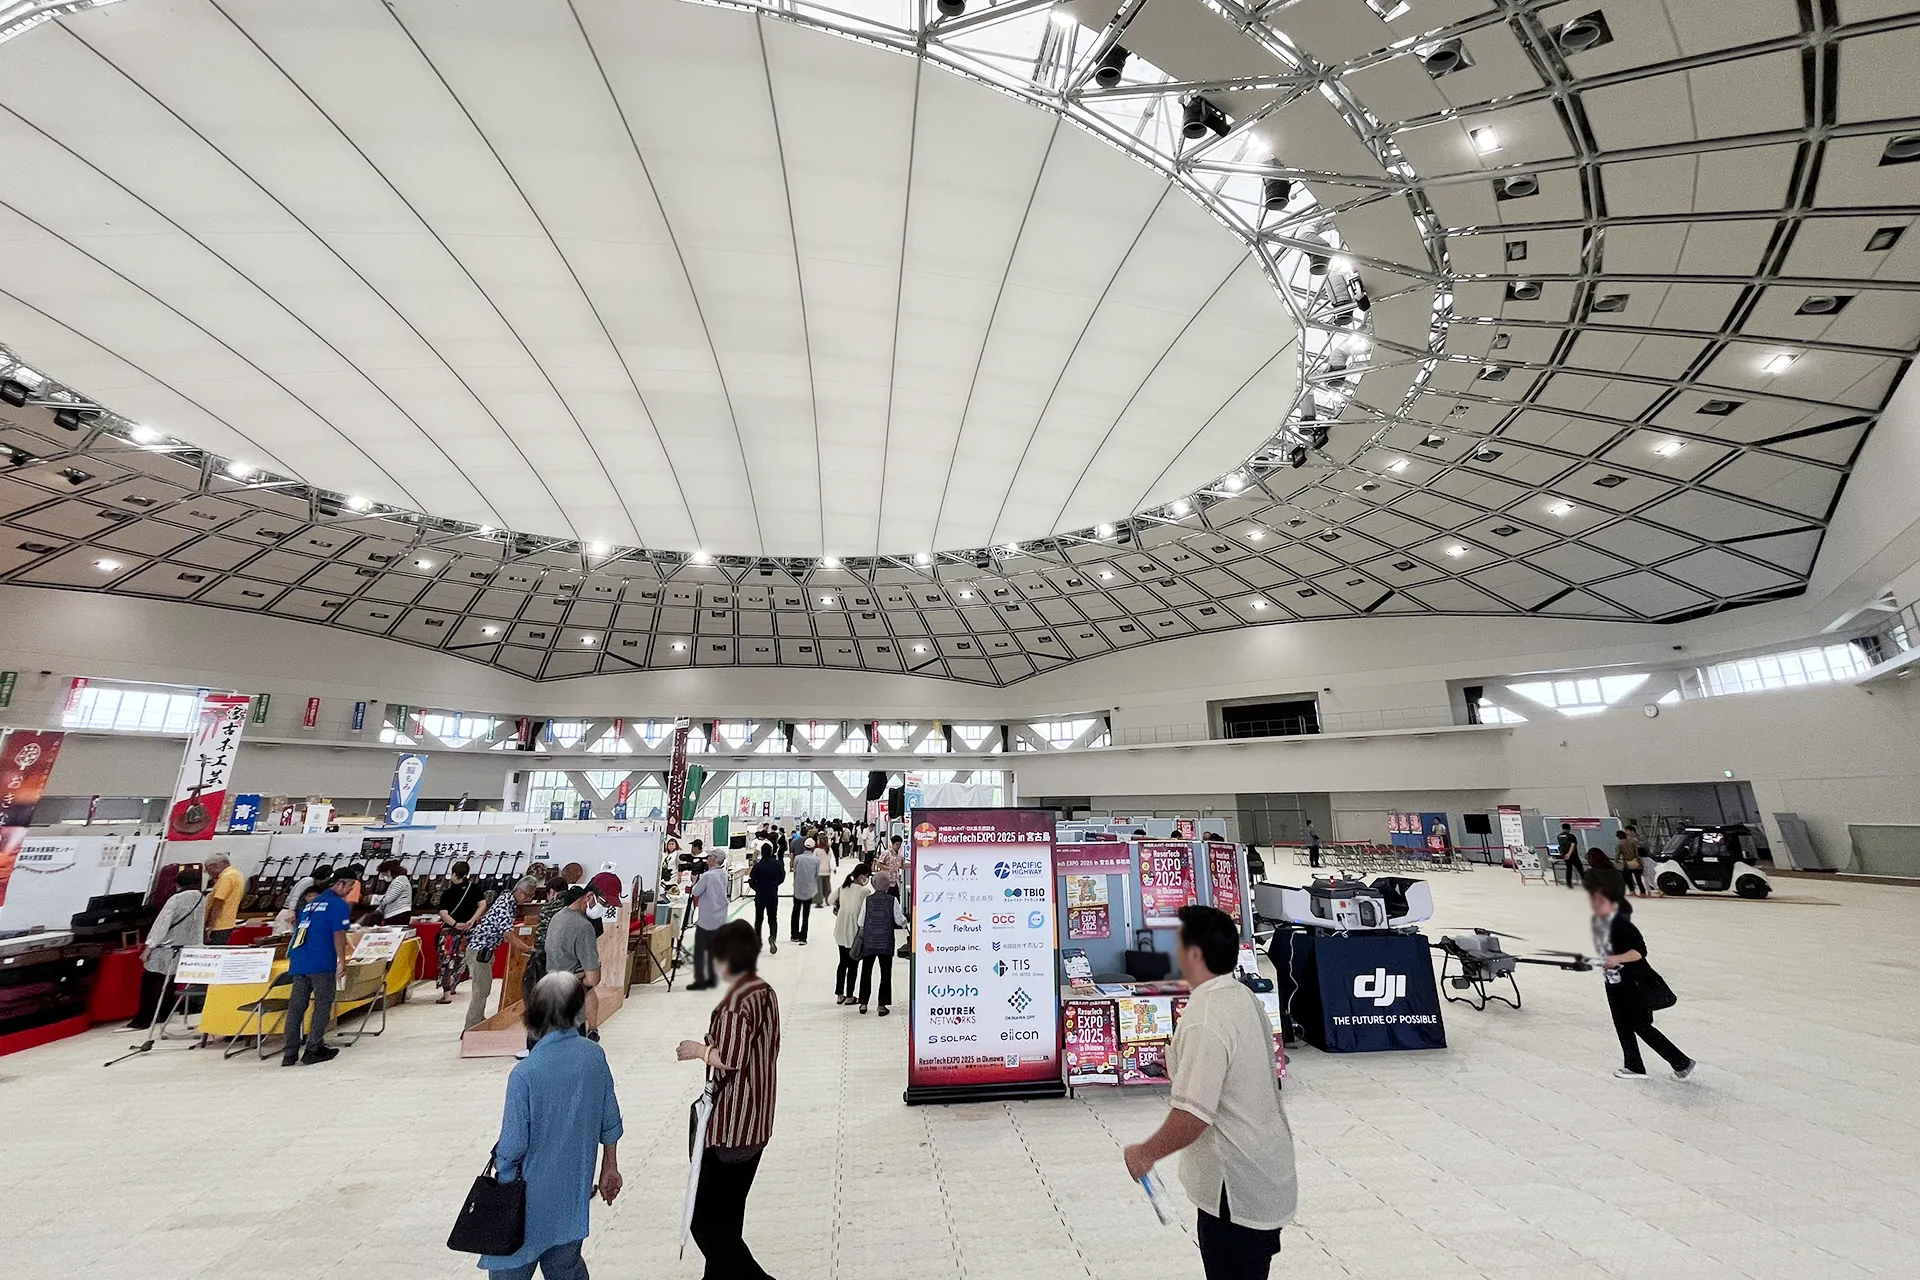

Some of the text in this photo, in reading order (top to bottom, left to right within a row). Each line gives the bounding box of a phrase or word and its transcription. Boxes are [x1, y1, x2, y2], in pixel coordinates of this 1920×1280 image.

[206, 706, 246, 785] 宮古木工芸
[938, 831, 1051, 843] ResorTech EXPO 2025 in 宮古島
[1153, 849, 1180, 858] ResorTech
[947, 861, 978, 876] Ark
[1012, 861, 1043, 869] PACIFIC
[1154, 858, 1181, 871] EXPO
[1216, 860, 1231, 874] EXPO
[1155, 871, 1182, 886] 2025
[1217, 873, 1233, 890] 2025
[1023, 888, 1045, 897] TBIO
[992, 915, 1015, 924] OCC
[1081, 914, 1097, 923] EXPO
[1082, 922, 1097, 931] 2025
[936, 944, 966, 953] toyopla
[928, 965, 978, 974] LIVING CG
[1012, 959, 1030, 970] TIS
[927, 984, 979, 998] Kubota
[1077, 1007, 1103, 1015] ResorTech
[930, 1015, 977, 1025] NETWORKS
[1077, 1015, 1103, 1029] EXPO
[1333, 1014, 1438, 1026] THE FUTURE OF POSSIBLE
[940, 1034, 978, 1043] SOLPAC
[1000, 1028, 1039, 1041] eiicon
[1078, 1028, 1104, 1043] 2025
[919, 1056, 946, 1065] ResorTech
[946, 1055, 960, 1064] EXPO
[960, 1055, 974, 1063] 2025
[982, 1055, 1004, 1063] Okinawa
[1139, 1052, 1158, 1062] EXPO
